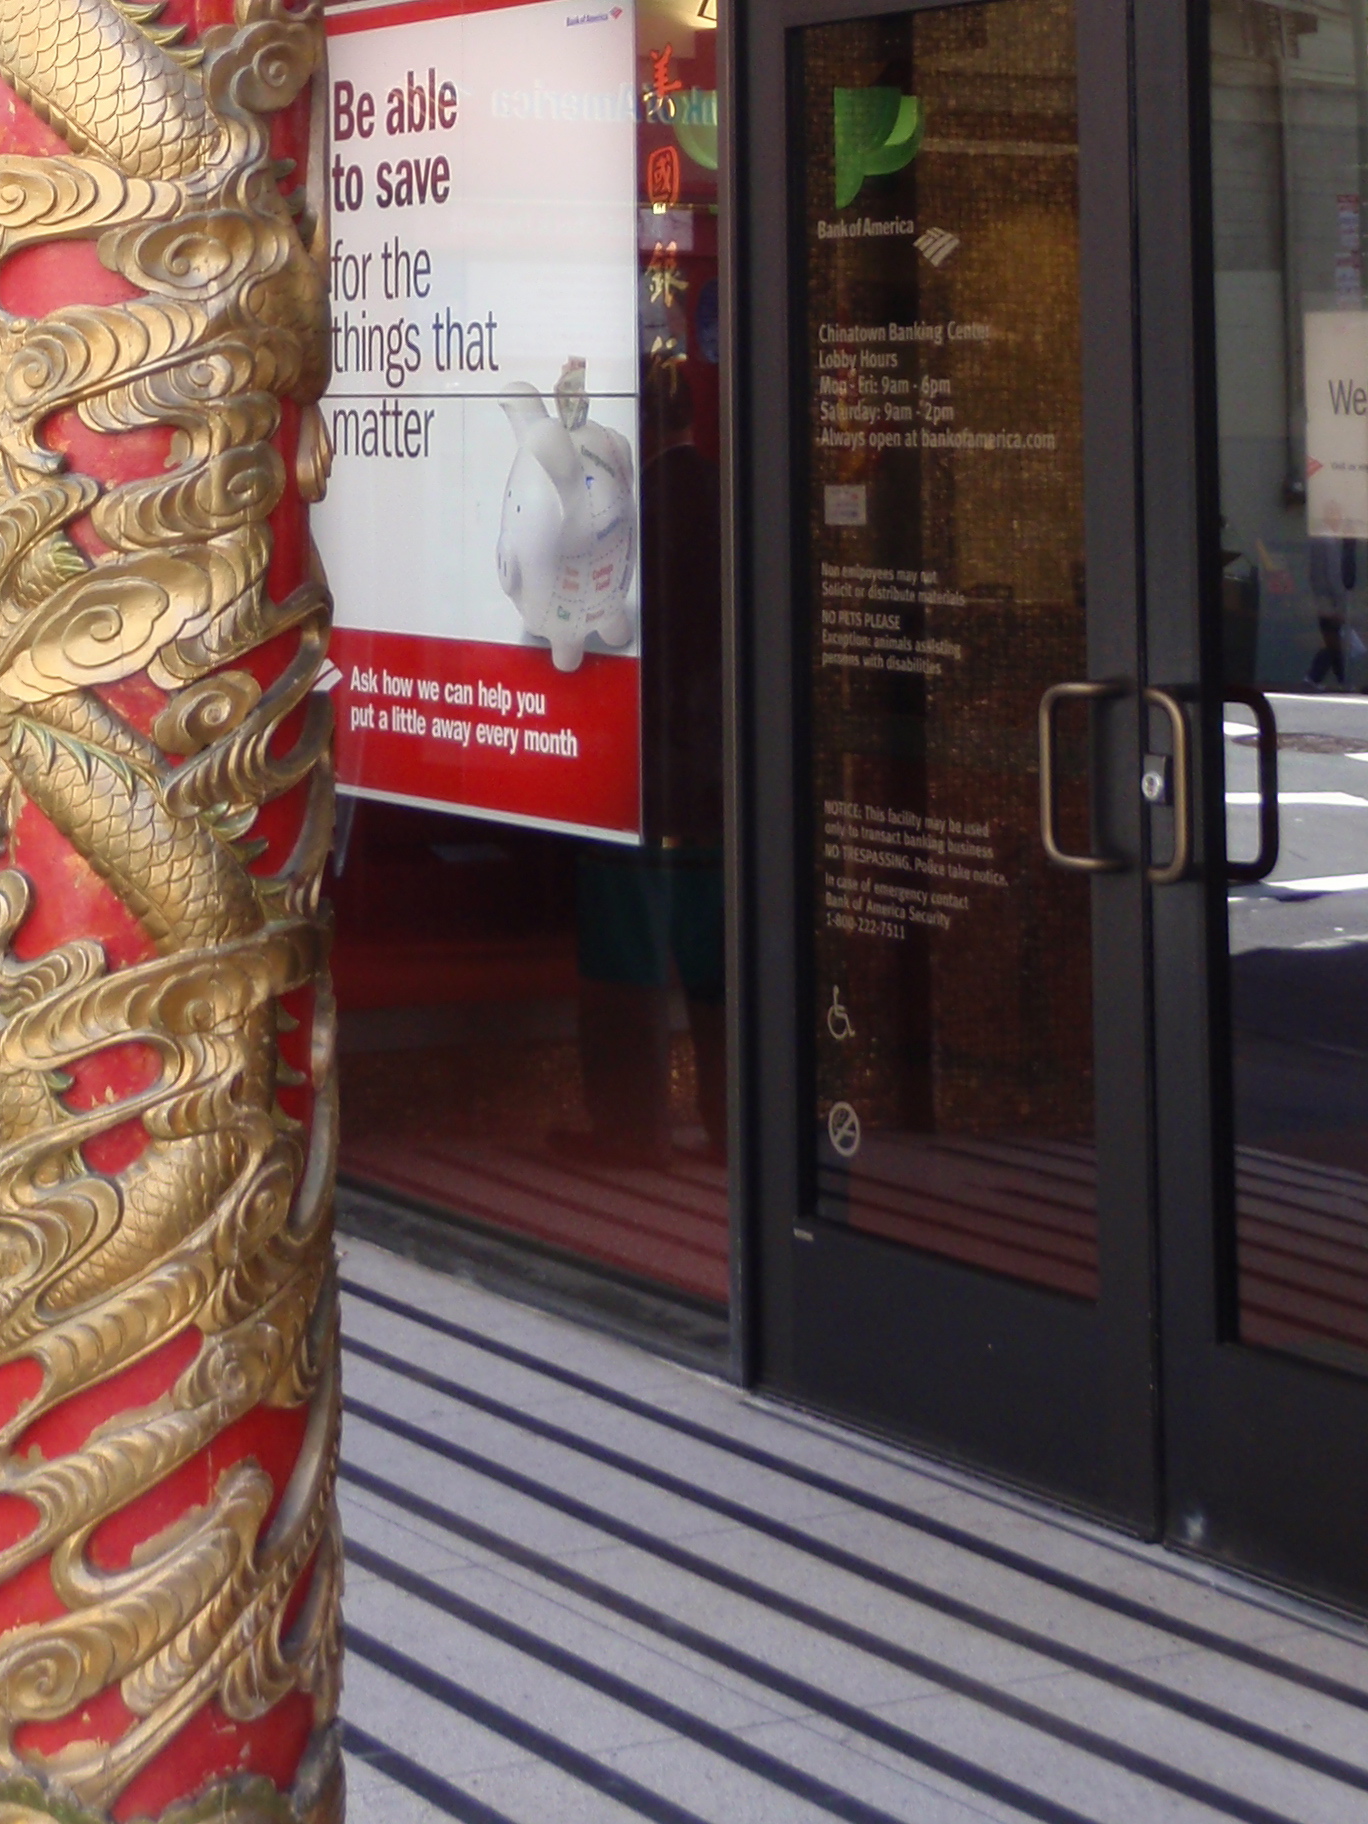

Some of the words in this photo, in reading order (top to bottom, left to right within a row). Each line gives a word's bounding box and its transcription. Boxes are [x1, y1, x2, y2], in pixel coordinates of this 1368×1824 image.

[333, 79, 375, 141] Be
[385, 67, 457, 136] able
[332, 153, 364, 212] to
[375, 154, 451, 209] save
[817, 219, 848, 239] Bank
[849, 218, 862, 237] of
[863, 216, 914, 236] America
[331, 238, 372, 301] for
[381, 236, 431, 300] the
[331, 310, 422, 388] things
[432, 306, 499, 373] that
[819, 324, 886, 343] Chinatown
[889, 321, 943, 345] Banking
[819, 350, 856, 369] Lobby
[860, 350, 898, 369] Hours
[858, 375, 878, 394] Fri:
[882, 376, 909, 395] 9am
[921, 375, 952, 398] 6pm
[333, 398, 435, 458] matter
[820, 399, 881, 424] Saturday:
[884, 402, 912, 421] 9am
[925, 402, 954, 425] 2pm
[821, 427, 866, 450] Always
[869, 430, 901, 451] open
[904, 429, 918, 447] at
[922, 427, 1055, 450] bankofamerica.com
[868, 583, 915, 603] distribute
[822, 609, 836, 624] NO
[838, 610, 862, 626] PETS
[864, 613, 901, 630] PLEASE
[862, 653, 884, 668] with
[350, 665, 379, 694] Ask
[382, 668, 414, 698] how
[417, 678, 440, 701] we
[444, 681, 473, 706] can
[478, 679, 512, 716] help
[516, 689, 546, 719] you
[350, 703, 375, 731] put
[378, 710, 388, 731] a
[391, 705, 427, 736] little
[431, 716, 472, 748] away
[475, 722, 519, 756] every
[524, 728, 579, 758] month
[865, 804, 885, 823] This
[888, 808, 922, 831] facility
[925, 816, 946, 833] may
[949, 816, 962, 833] be
[861, 827, 902, 845] transact
[903, 833, 945, 855] banking
[948, 838, 994, 859] business
[825, 843, 839, 858] NO
[914, 857, 945, 876] Police
[948, 863, 971, 880] take
[825, 872, 835, 887] In
[836, 877, 858, 891] case
[861, 877, 872, 893] of
[874, 883, 928, 906] emergency
[931, 893, 969, 910] contact
[866, 899, 906, 919] America
[909, 905, 950, 931] Security
